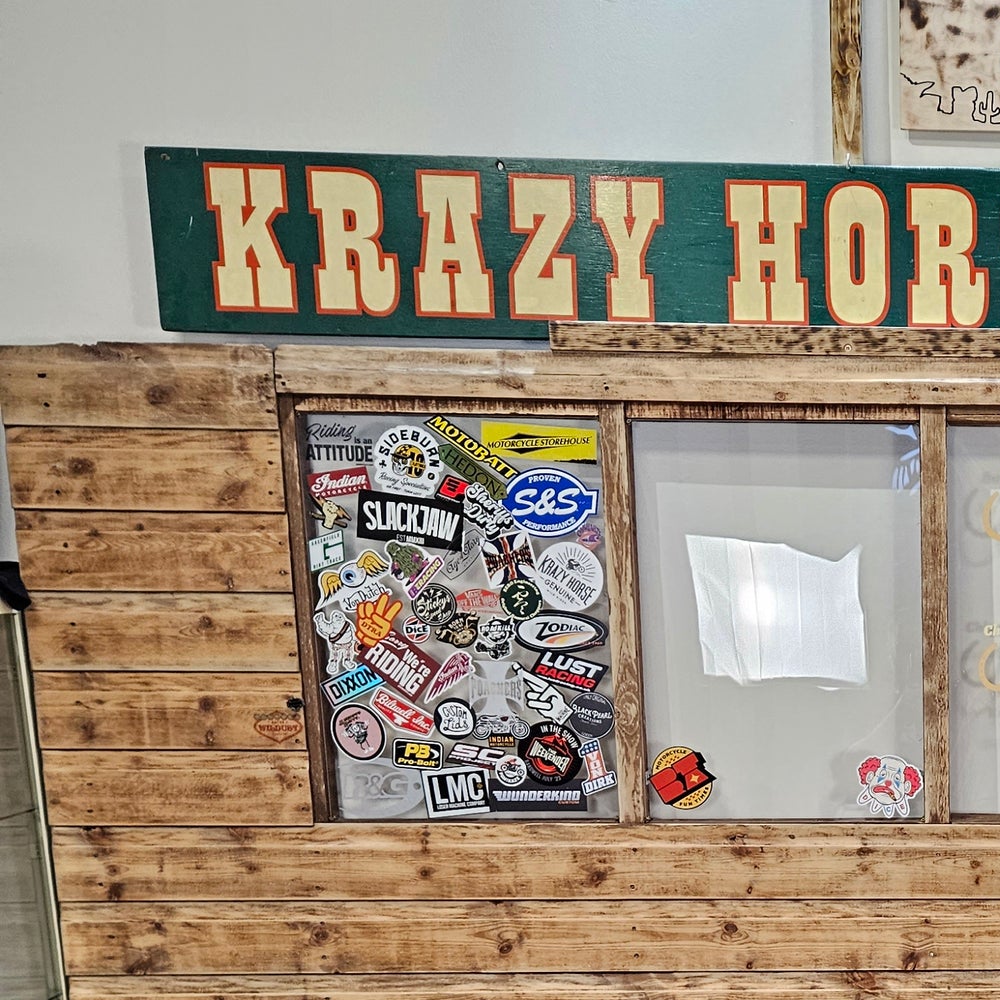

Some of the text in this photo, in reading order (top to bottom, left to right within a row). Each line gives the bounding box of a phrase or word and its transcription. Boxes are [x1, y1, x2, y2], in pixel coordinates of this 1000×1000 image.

[203, 161, 664, 321] KRAZY
[306, 423, 356, 441] Riding
[487, 436, 591, 449] MOTORCYCLE STOREHOUSE
[306, 445, 373, 462] ATTITUDE
[379, 429, 440, 468] SIDEBURN
[428, 415, 518, 478] MOTOBATT
[311, 474, 367, 493] Indian
[444, 450, 500, 495] HEDON
[528, 475, 561, 484] PROVEN
[512, 488, 580, 516] S&S
[363, 501, 460, 542] SLACKJAW
[522, 517, 576, 531] PERFORMANCE
[538, 555, 568, 582] KRAZY
[567, 576, 597, 606] HORSE
[544, 579, 574, 604] GENUINE
[536, 621, 585, 642] ZODIAC
[364, 643, 425, 695] RIDING
[402, 648, 431, 677] We're
[540, 651, 602, 678] LUST
[329, 668, 378, 699] DIXXON
[535, 665, 596, 689] RACING
[572, 704, 592, 717] BLACK
[540, 725, 549, 734] IN
[548, 725, 562, 735] THE
[561, 729, 579, 749] SHOW
[404, 743, 431, 758] PB
[451, 744, 505, 761] SC
[529, 740, 570, 773] WEEKENDER
[656, 749, 687, 770] MOTORCYCLE
[432, 773, 484, 805] LMC
[584, 773, 615, 794] DIRK
[694, 786, 709, 804] TIMES
[493, 790, 581, 802] WUNDERKIND
